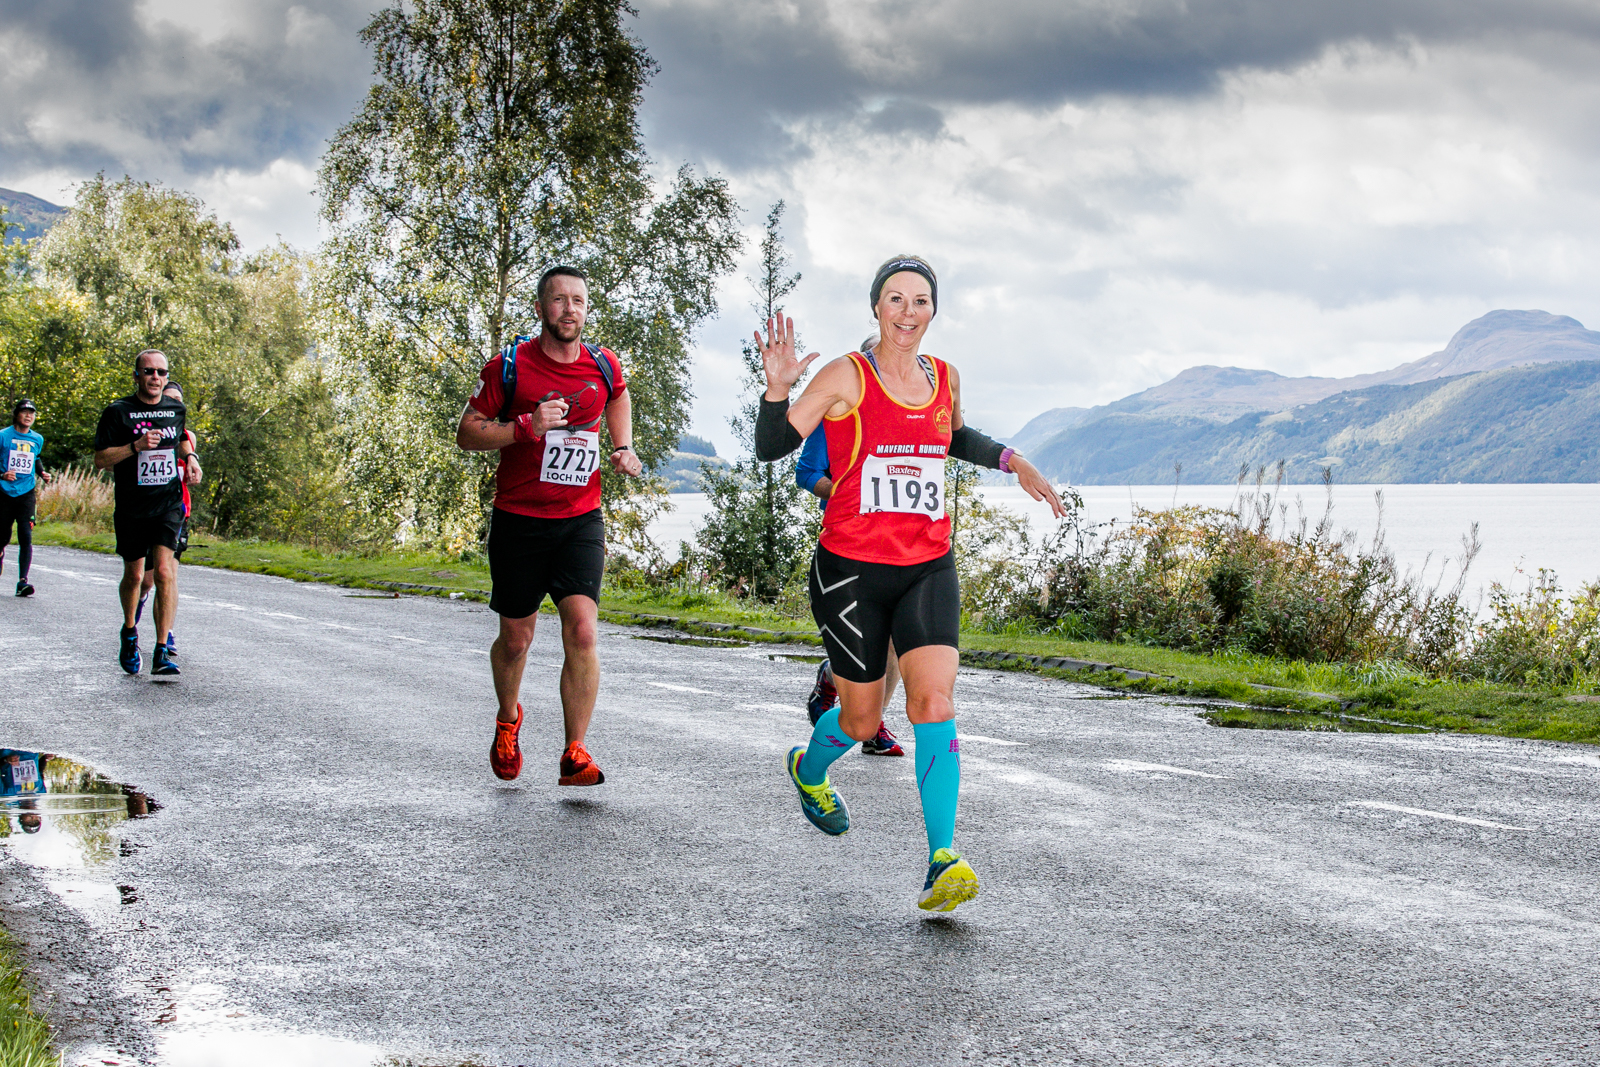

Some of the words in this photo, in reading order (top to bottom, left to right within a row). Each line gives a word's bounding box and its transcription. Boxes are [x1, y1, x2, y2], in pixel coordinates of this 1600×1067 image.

[129, 410, 175, 419] RAYMOND
[876, 444, 915, 454] MAVERICK
[10, 457, 32, 469] 3835
[547, 446, 597, 473] 2727
[140, 460, 173, 476] 2445
[888, 466, 920, 477] Baxters
[546, 471, 573, 482] LOCH
[575, 474, 591, 483] NE
[871, 476, 940, 512] 1193
